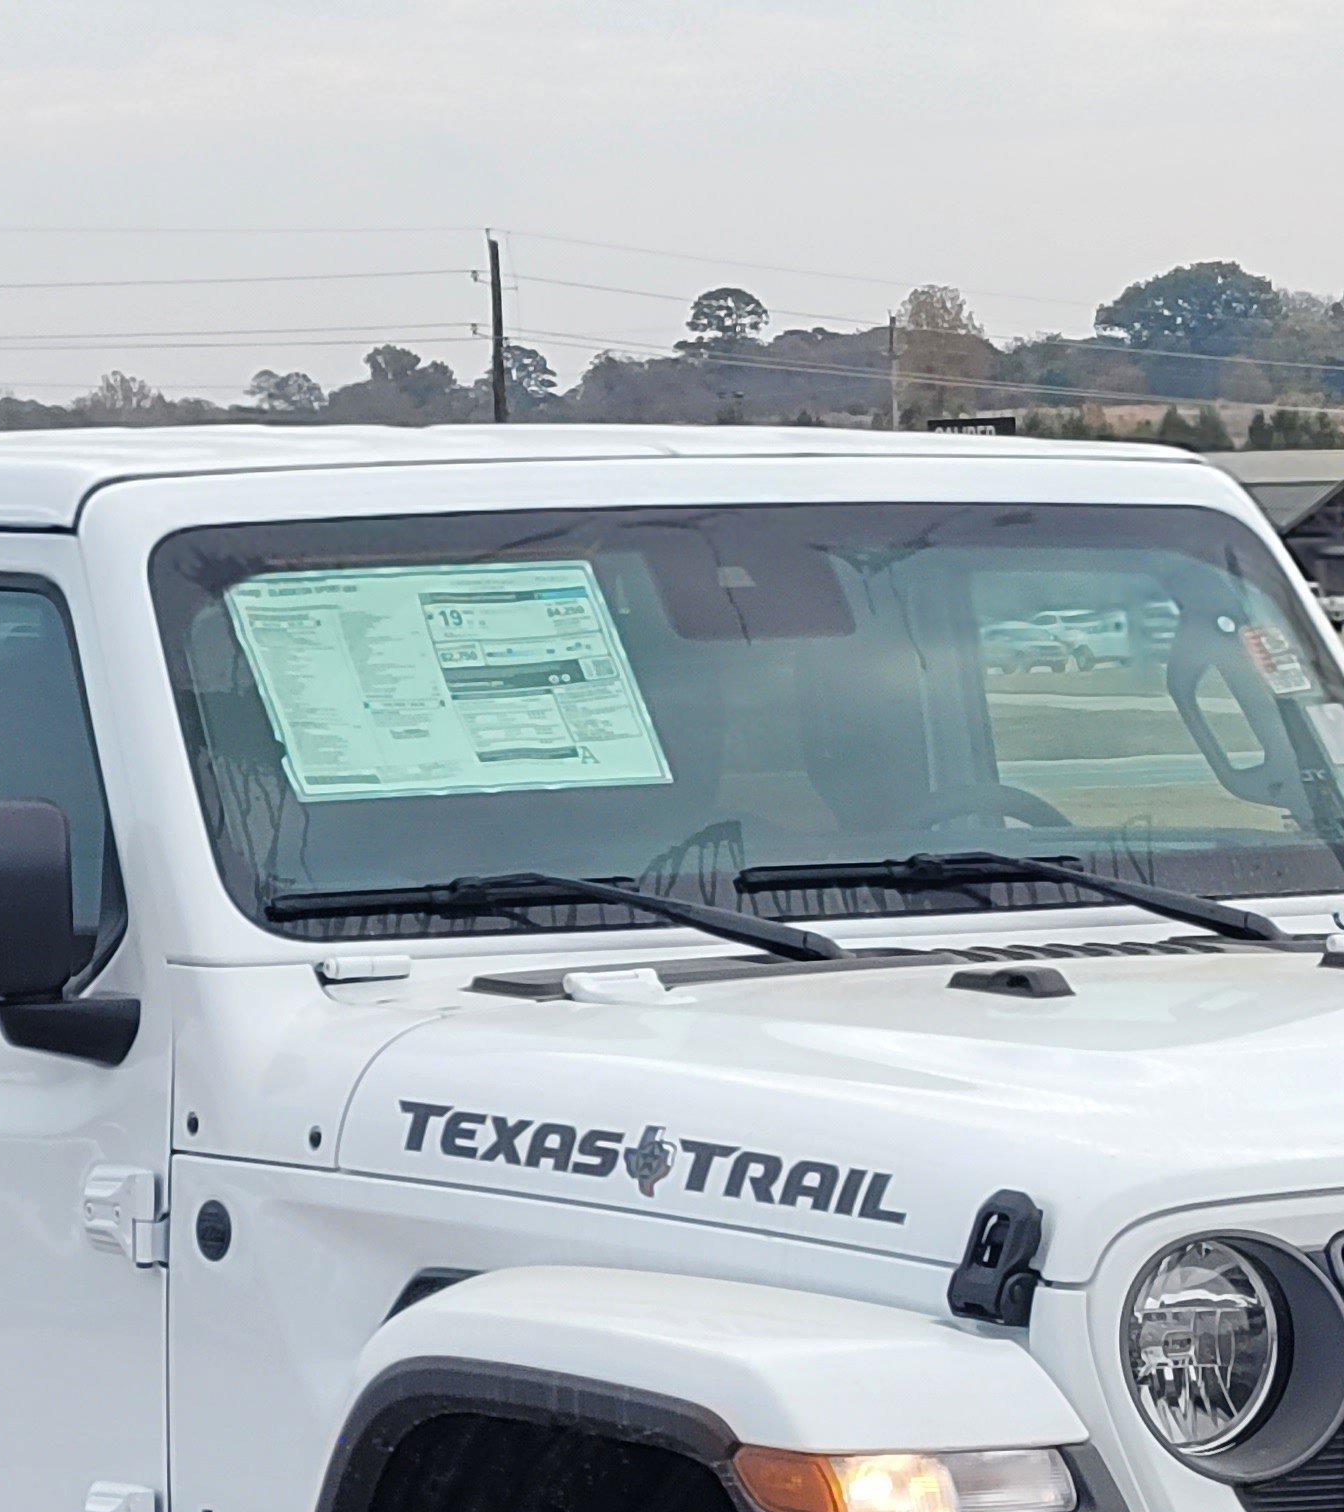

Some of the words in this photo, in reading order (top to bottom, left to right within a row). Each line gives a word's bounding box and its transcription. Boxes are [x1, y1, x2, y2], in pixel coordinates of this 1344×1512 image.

[439, 609, 464, 627] 19
[398, 1099, 625, 1177] TEXAS
[679, 1138, 907, 1225] TRAIL
